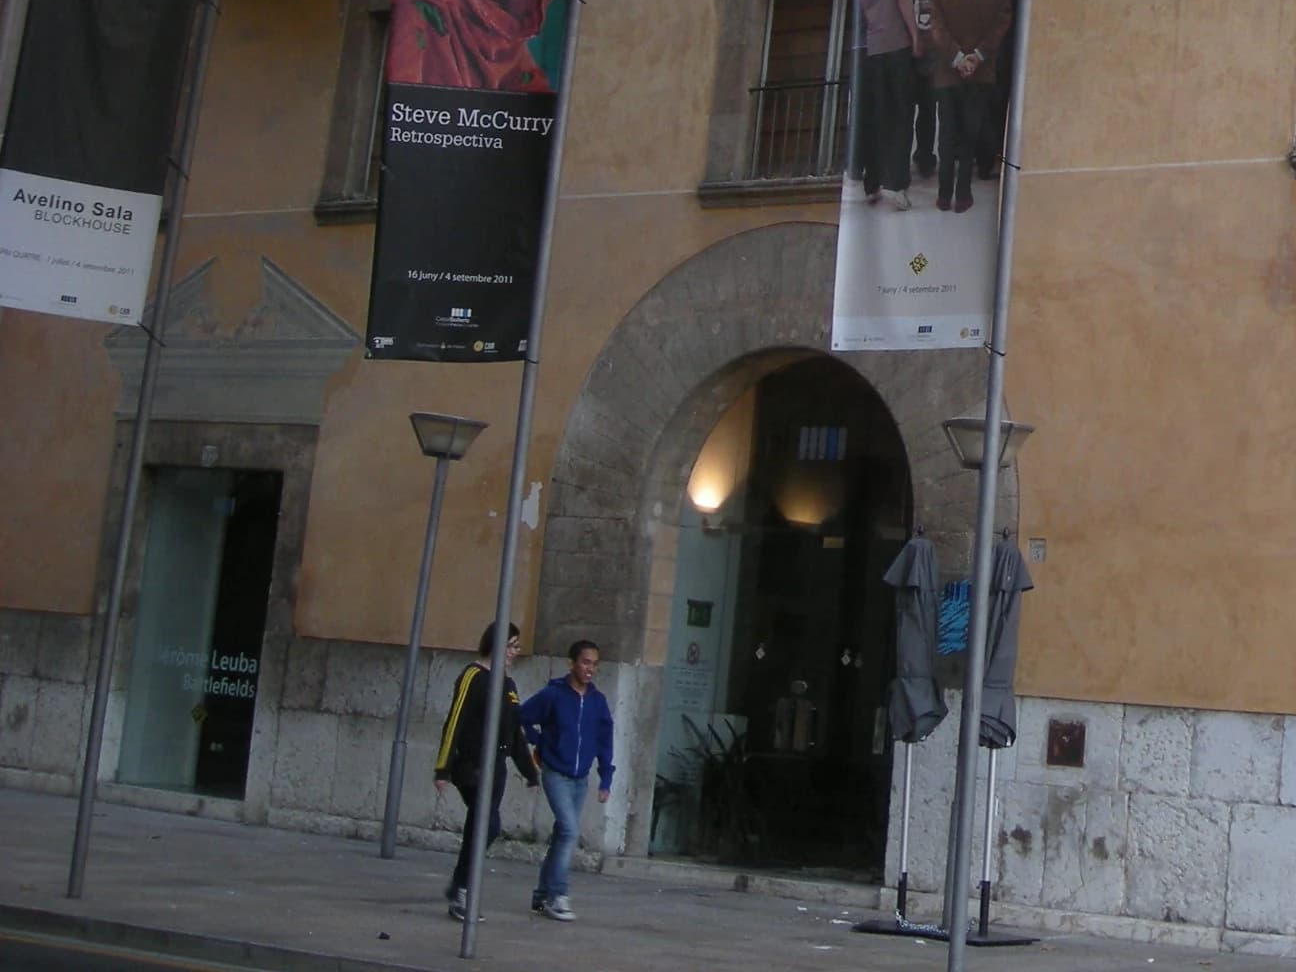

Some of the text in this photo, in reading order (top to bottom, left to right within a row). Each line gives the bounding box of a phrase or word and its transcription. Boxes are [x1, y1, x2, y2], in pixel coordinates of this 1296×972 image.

[391, 103, 555, 136] Steve McCurry
[390, 127, 504, 149] Retrospectiva
[13, 188, 133, 221] Avelino Sala
[34, 209, 132, 235] BLOCKHOUSE
[407, 269, 418, 279] 16
[418, 270, 439, 281] juny
[445, 273, 451, 281] 4
[452, 274, 492, 284] setembre
[493, 275, 514, 284] 2011
[940, 284, 957, 293] 2011
[212, 649, 258, 674] Leuba
